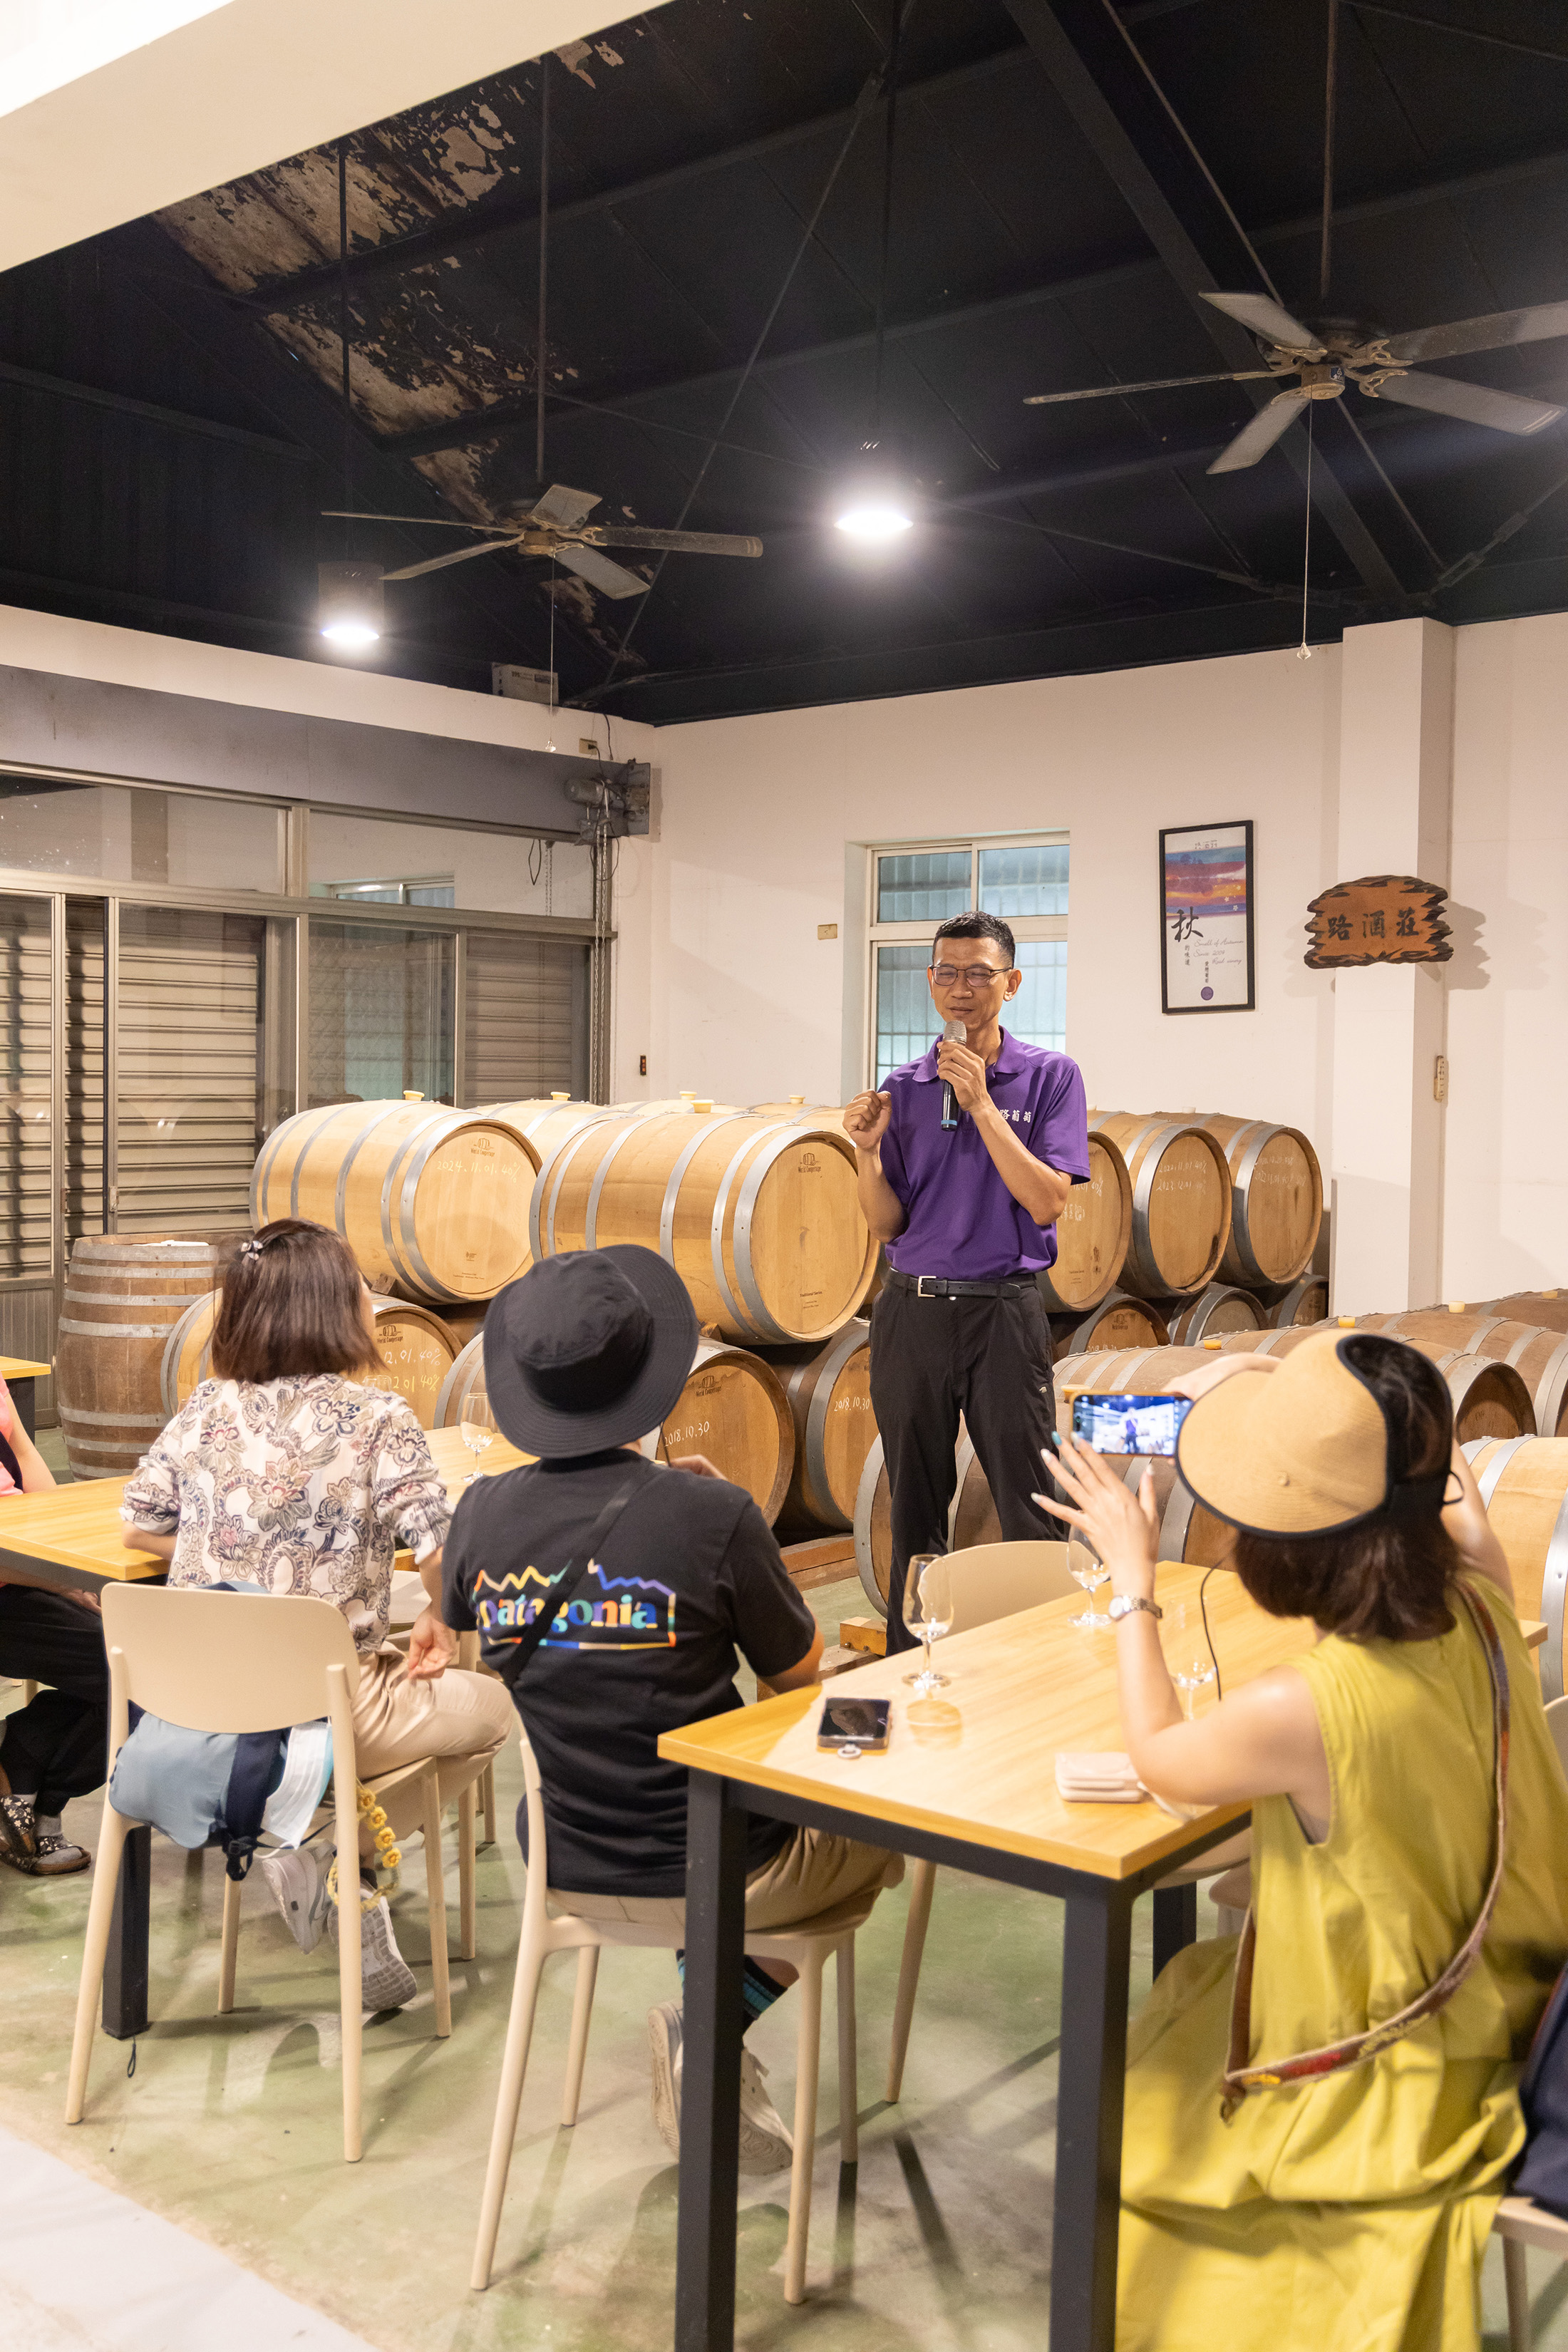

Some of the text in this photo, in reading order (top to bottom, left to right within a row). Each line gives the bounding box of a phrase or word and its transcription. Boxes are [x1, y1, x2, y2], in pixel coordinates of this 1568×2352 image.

[1171, 906, 1204, 942] 秋
[1327, 907, 1419, 940] 路酒莊
